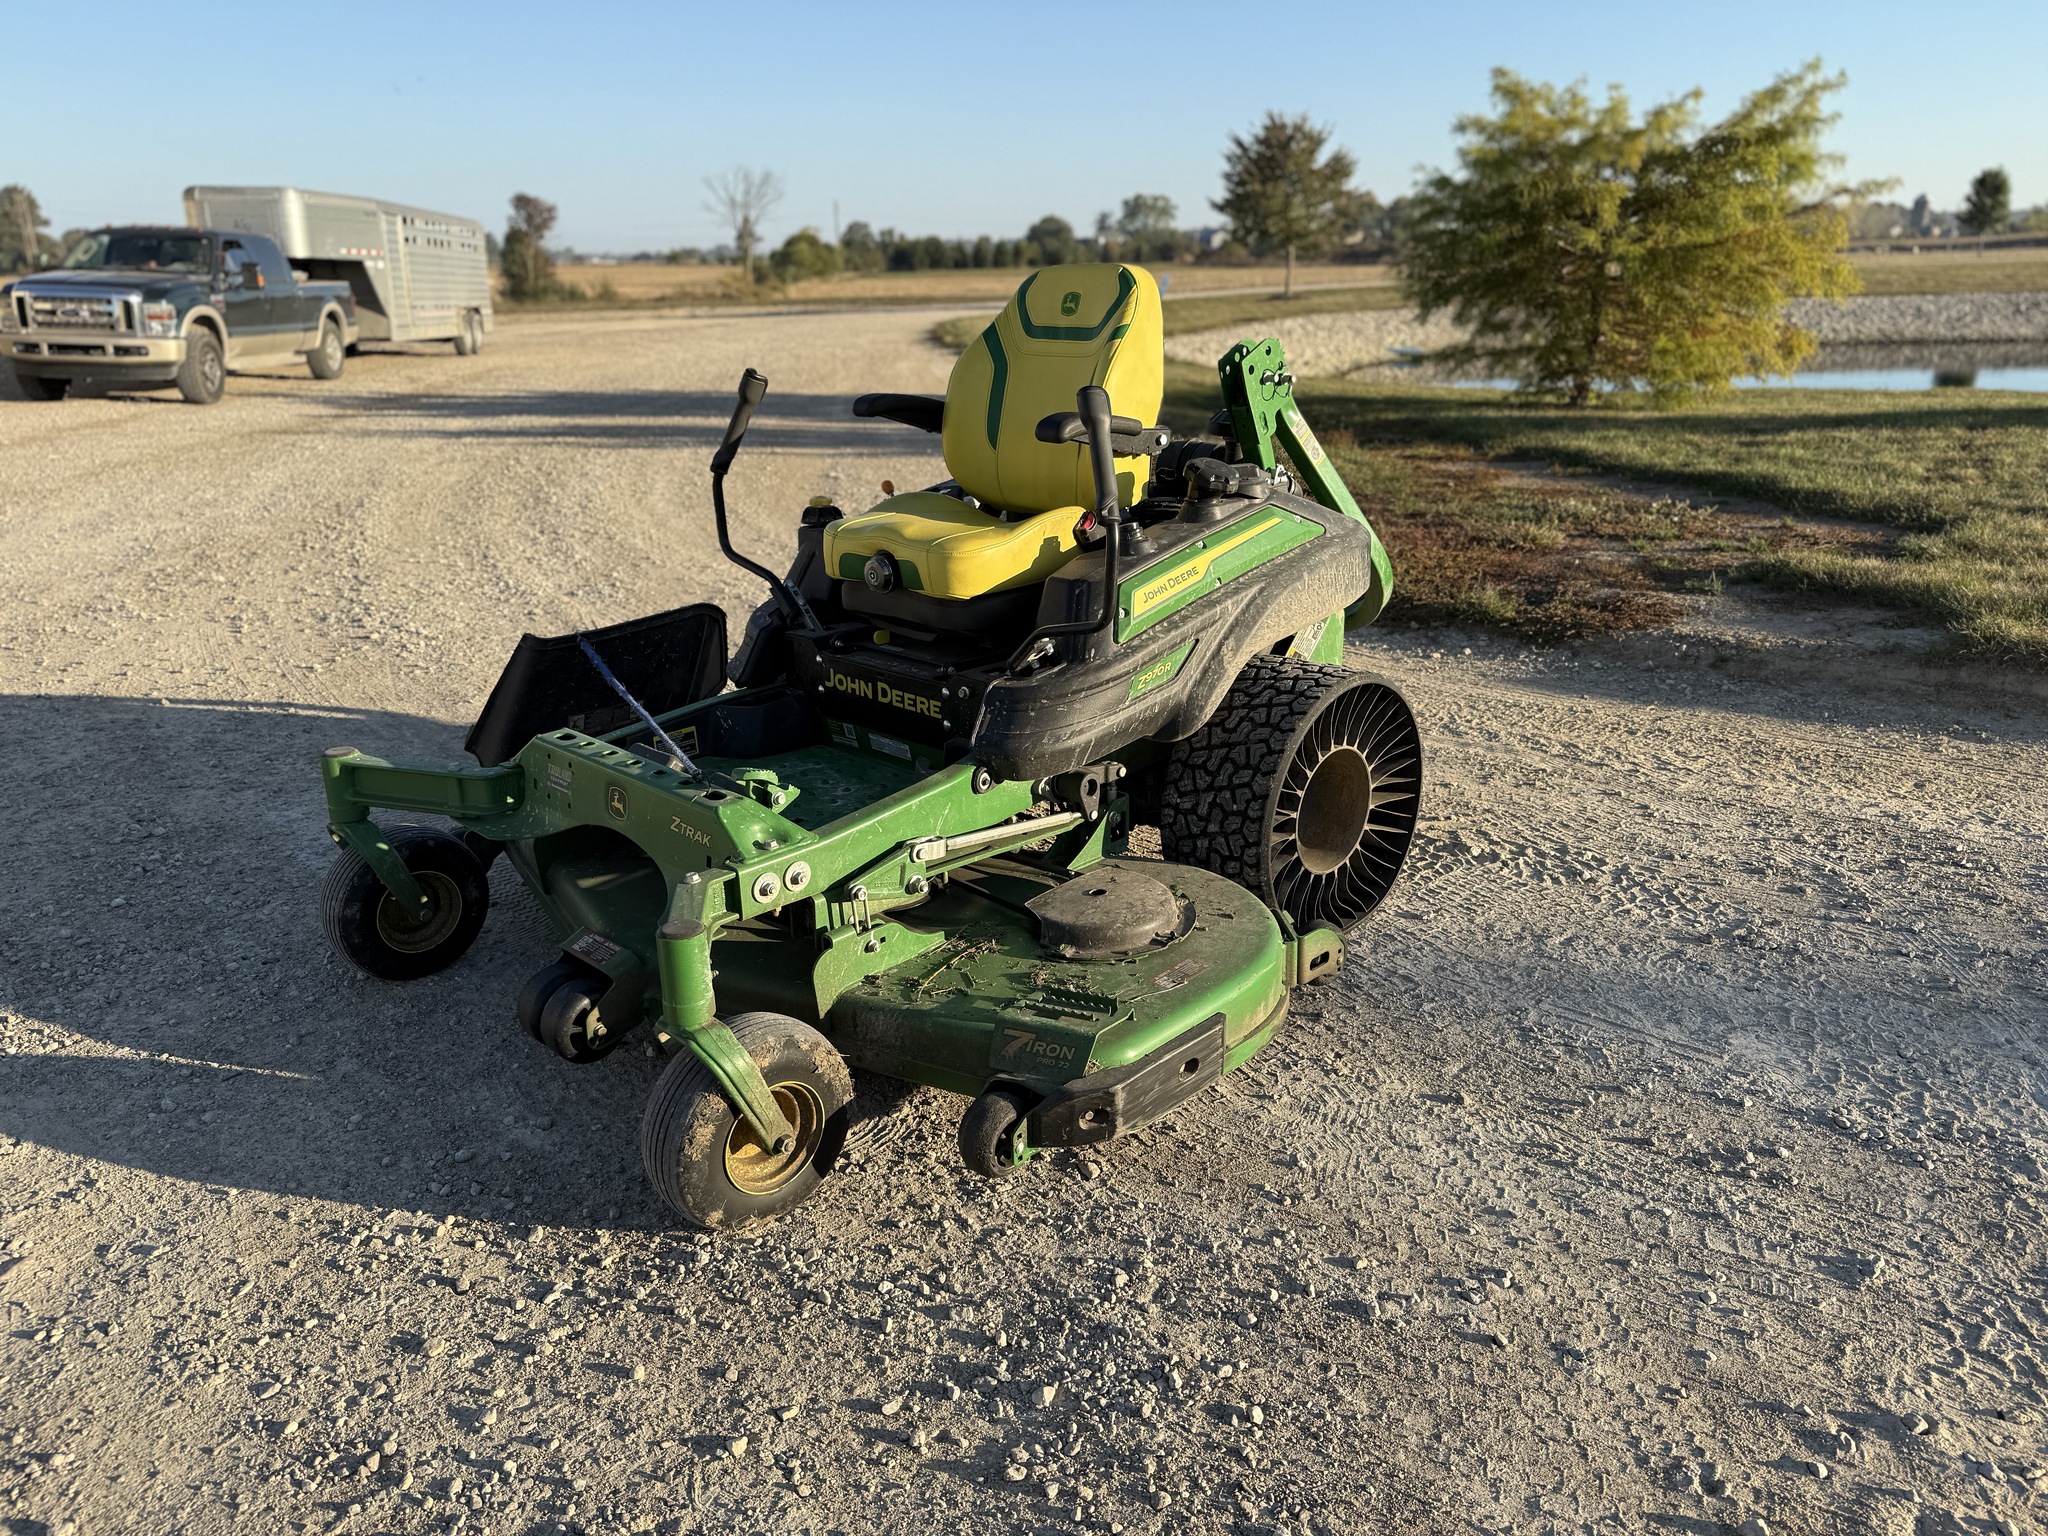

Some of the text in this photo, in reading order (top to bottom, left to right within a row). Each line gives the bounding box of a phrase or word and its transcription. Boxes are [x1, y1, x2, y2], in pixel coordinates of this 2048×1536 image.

[1143, 566, 1199, 604] JOHN DEERE
[1137, 661, 1172, 690] Z970R
[825, 668, 943, 719] JOHN DEERE
[670, 815, 712, 848] ZTRAK
[1036, 1056, 1070, 1070] PRO 72
